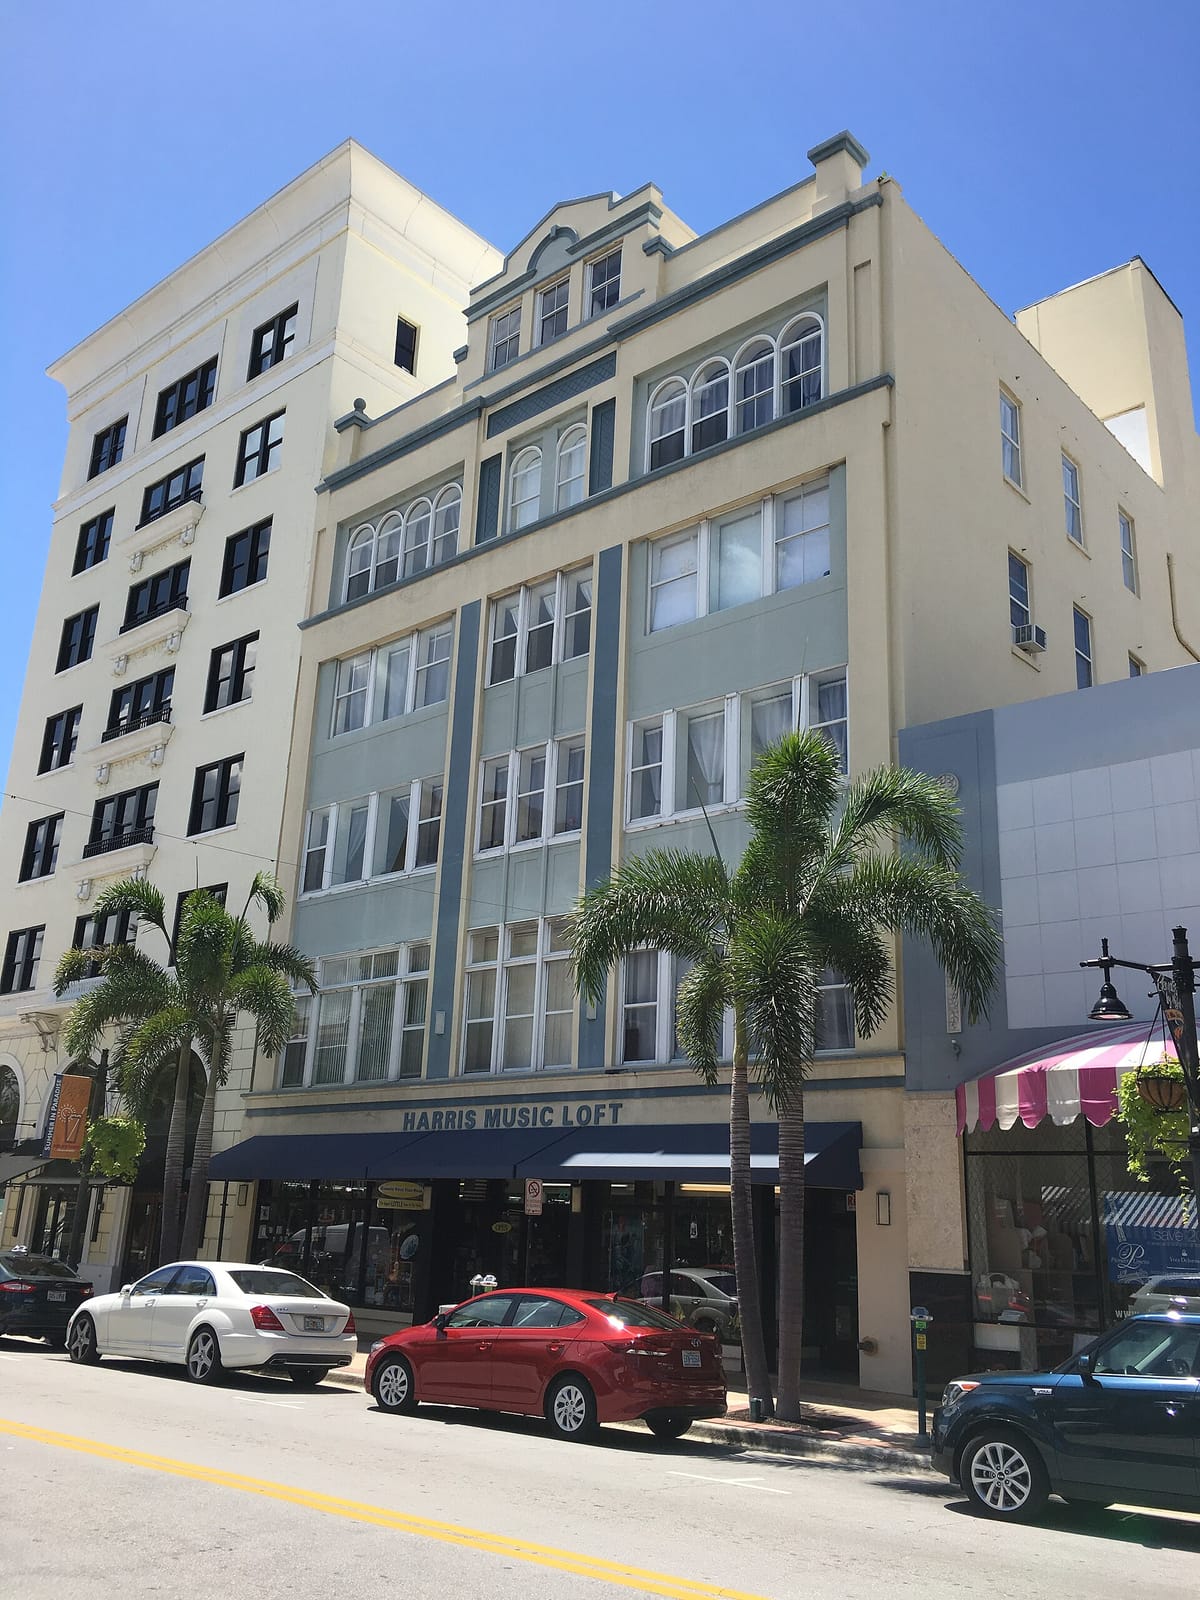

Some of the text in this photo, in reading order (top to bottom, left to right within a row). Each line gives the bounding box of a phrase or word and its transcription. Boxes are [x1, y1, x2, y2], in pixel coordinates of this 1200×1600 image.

[44, 1119, 55, 1152] SUMMER
[51, 1079, 63, 1112] PARADISE
[402, 1103, 623, 1131] HARRIS MUSIC LOFT
[1153, 1230, 1184, 1242] save
